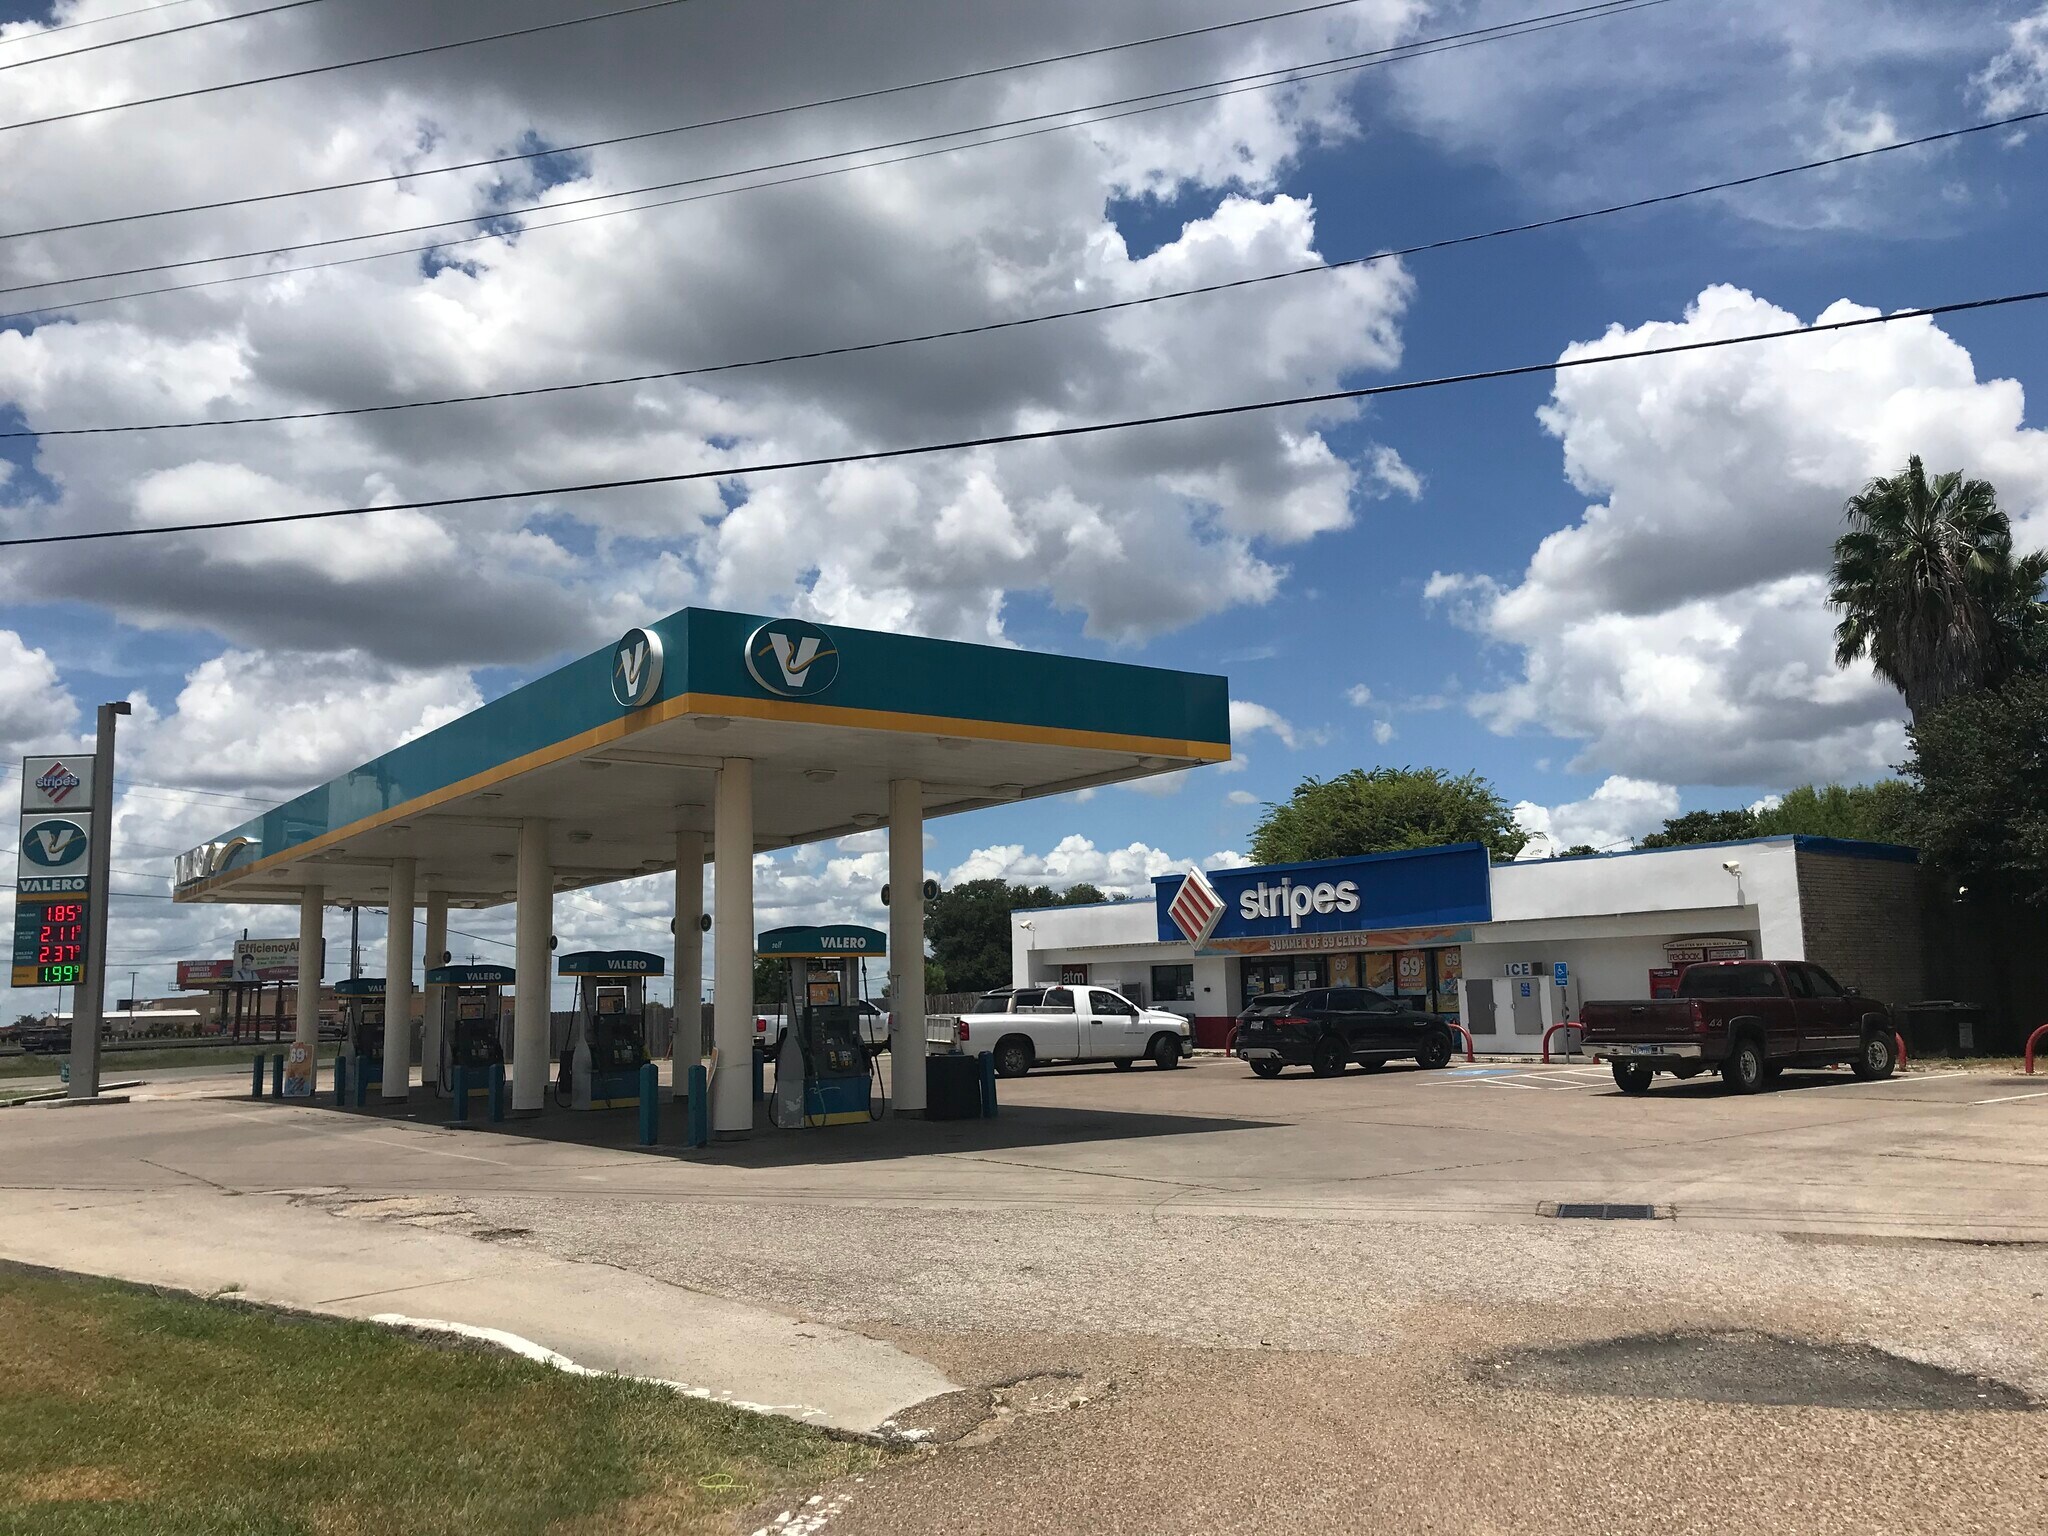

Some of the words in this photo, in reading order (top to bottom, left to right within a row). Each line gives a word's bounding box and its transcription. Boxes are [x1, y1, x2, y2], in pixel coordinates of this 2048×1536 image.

[37, 776, 78, 789] stripes
[19, 878, 86, 892] VALERO
[1240, 877, 1360, 929] stripes
[238, 941, 299, 954] EfficiencyAi
[820, 936, 867, 949] VALERO
[1269, 939, 1308, 951] SUMMER
[1309, 938, 1321, 949] OF
[1322, 937, 1335, 948] 69
[1336, 935, 1368, 947] CENTS
[607, 959, 648, 970] VALERO
[1335, 959, 1348, 971] 69
[1505, 963, 1530, 976] ICE
[466, 972, 502, 980] VALERO
[1063, 970, 1084, 984] atm
